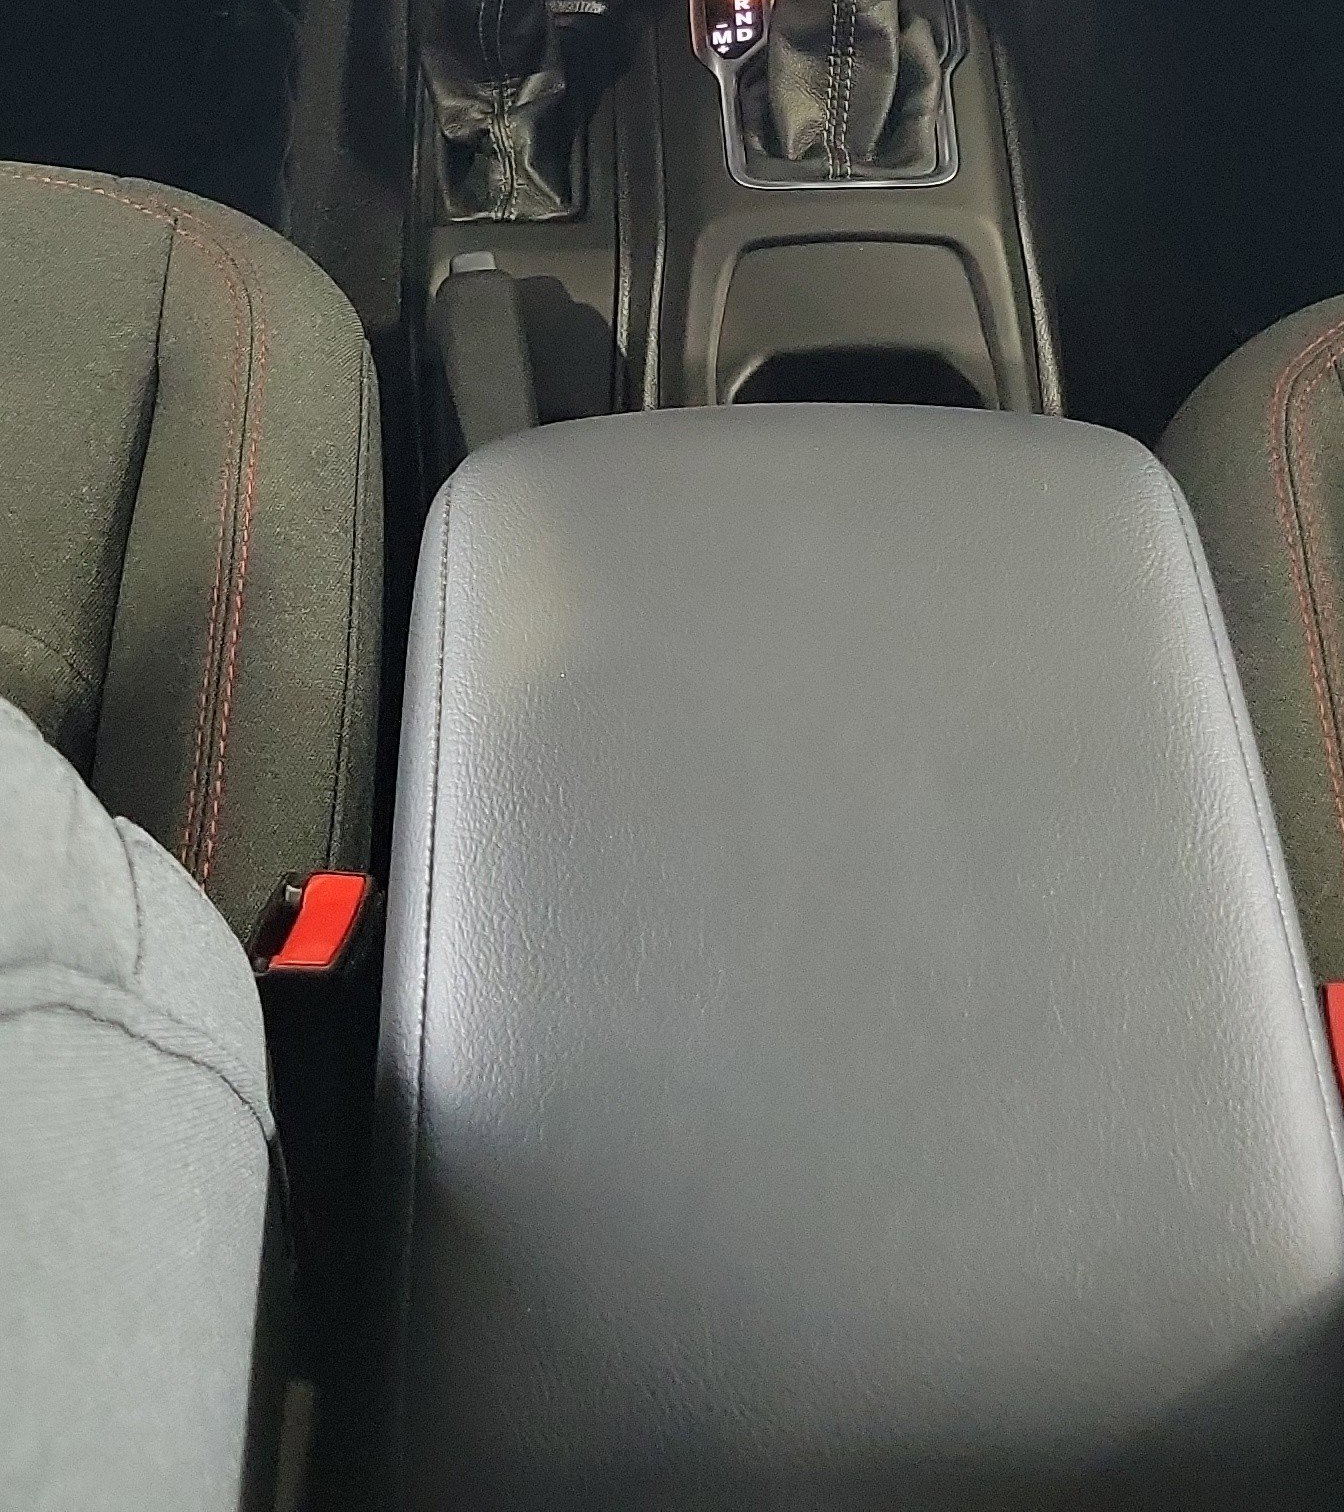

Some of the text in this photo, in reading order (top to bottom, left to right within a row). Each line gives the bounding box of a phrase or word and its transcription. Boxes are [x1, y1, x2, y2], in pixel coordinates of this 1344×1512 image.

[736, 12, 753, 26] N
[712, 30, 732, 45] M
[736, 28, 753, 42] D
